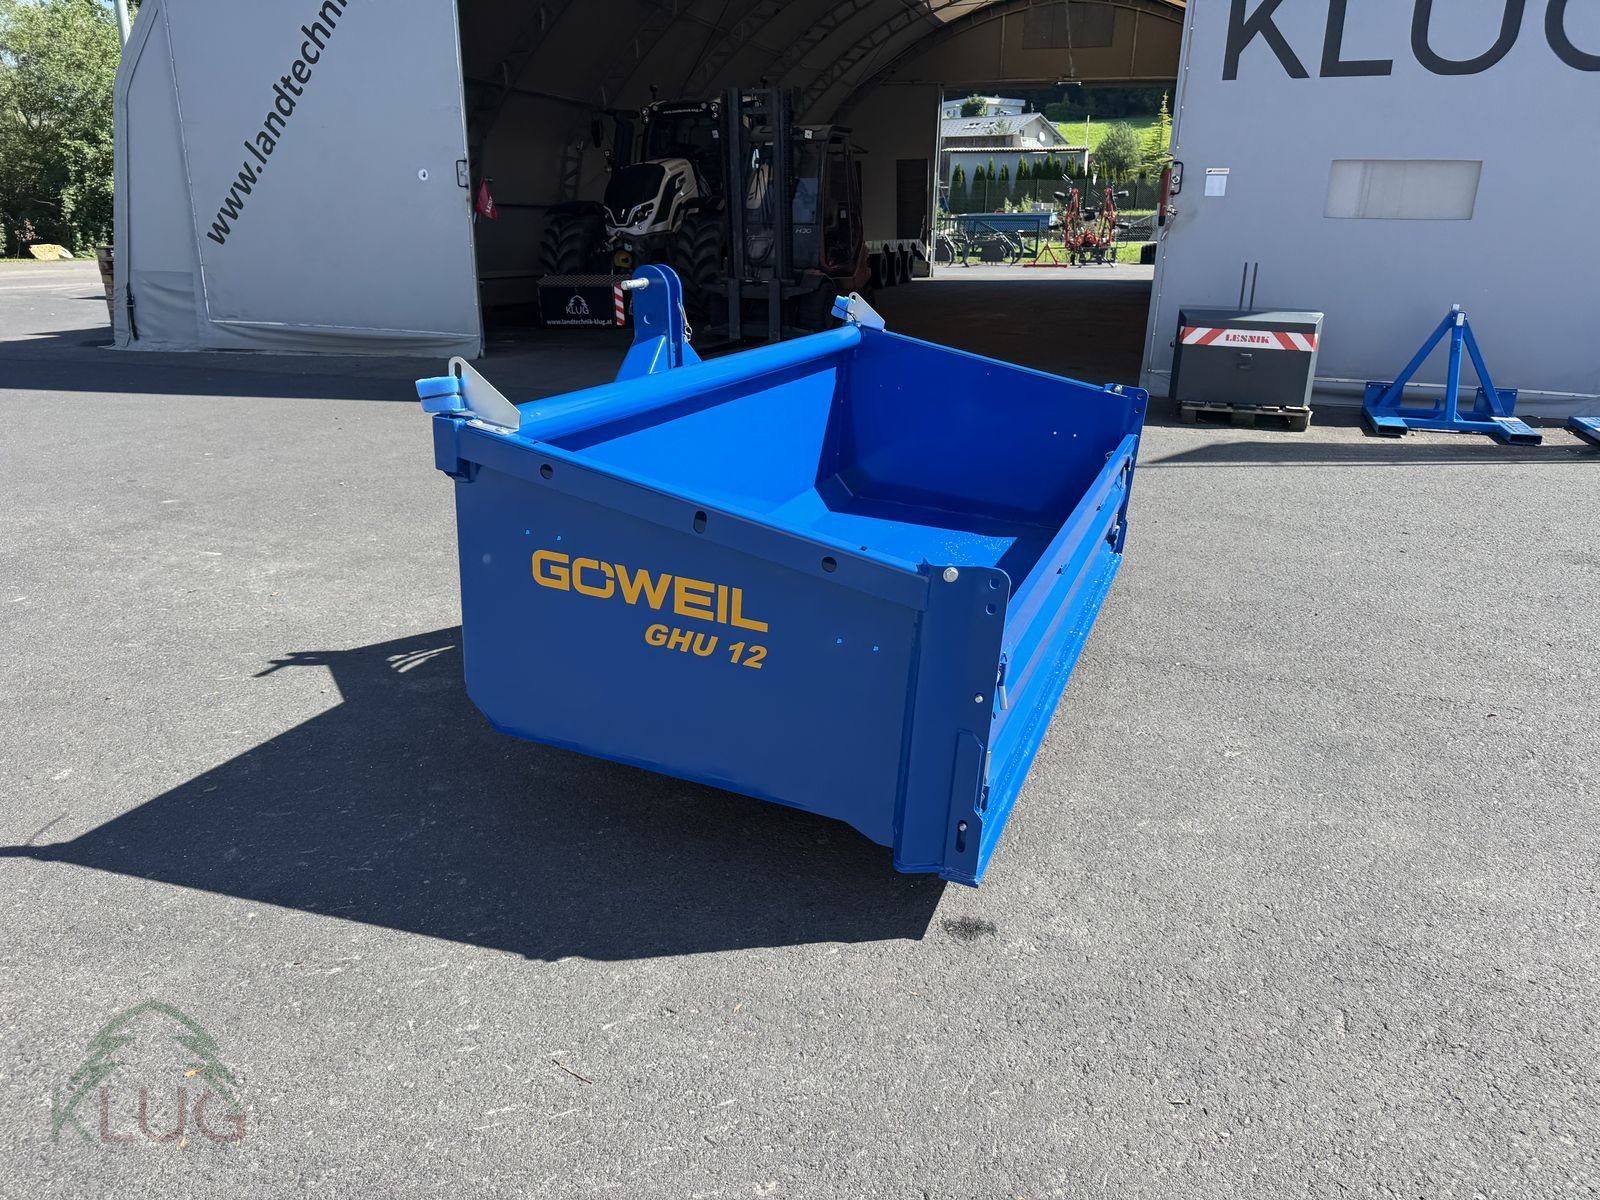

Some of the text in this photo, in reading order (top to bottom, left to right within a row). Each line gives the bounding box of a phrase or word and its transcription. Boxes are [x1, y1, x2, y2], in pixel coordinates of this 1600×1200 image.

[565, 305, 590, 315] KLUG
[1225, 334, 1270, 344] LESNIK
[645, 624, 768, 668] GHU 12
